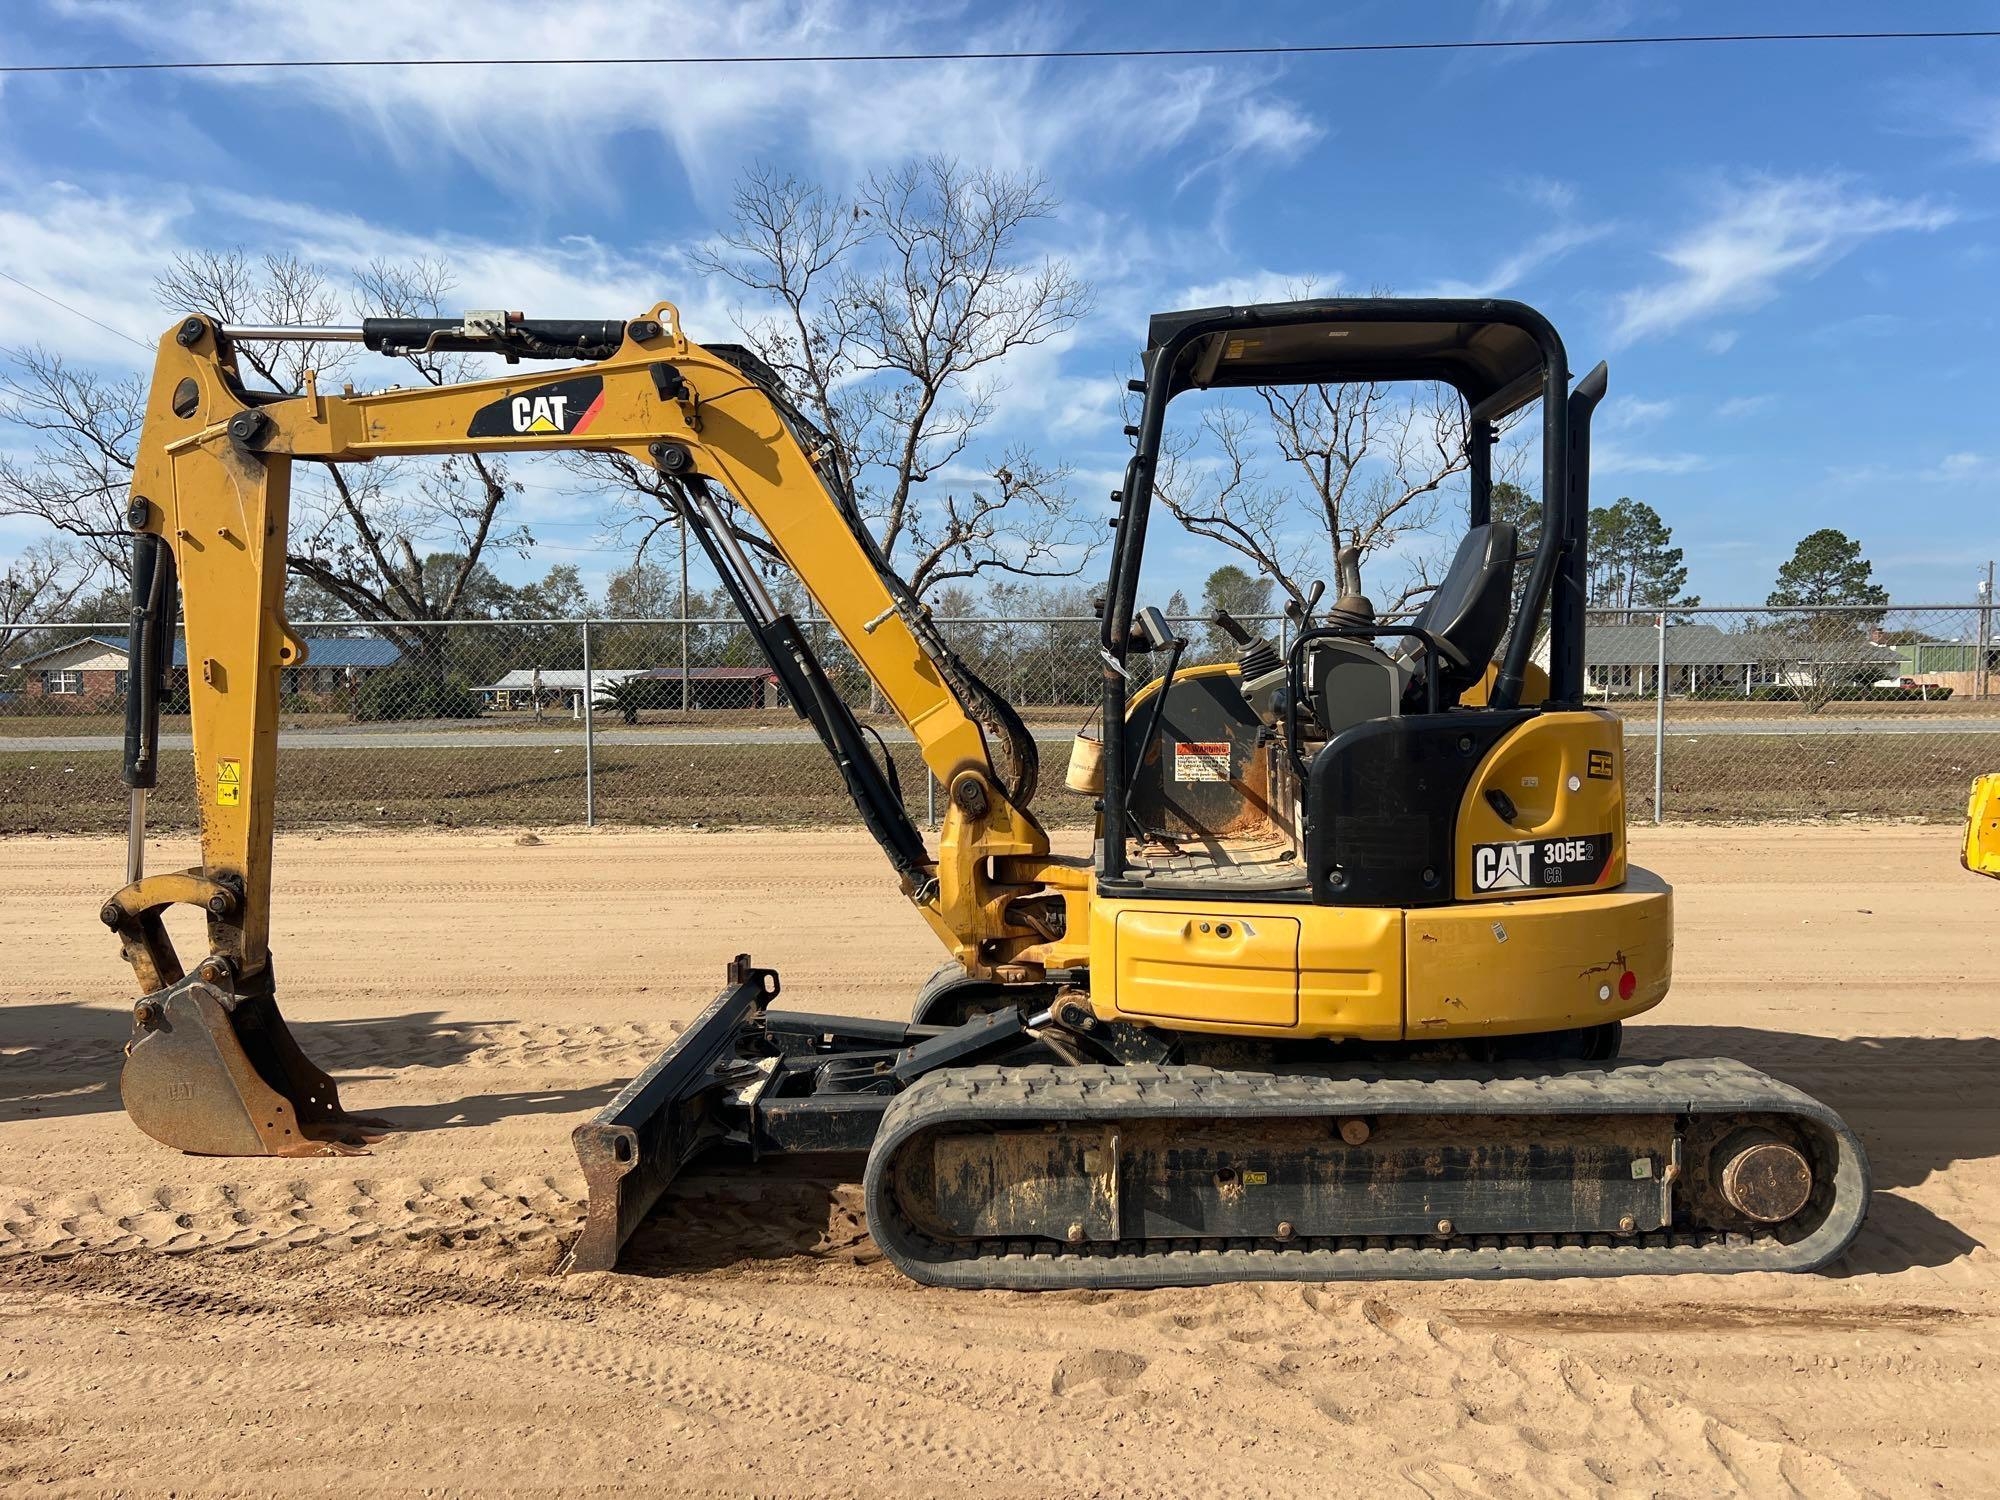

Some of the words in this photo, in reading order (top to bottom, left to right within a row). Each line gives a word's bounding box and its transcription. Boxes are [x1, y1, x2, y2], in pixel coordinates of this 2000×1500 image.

[512, 396, 568, 432] CAT
[1191, 745, 1227, 753] WARNING
[1544, 840, 1594, 864] 305E2
[1476, 845, 1534, 889] CAT
[1544, 867, 1562, 883] CR
